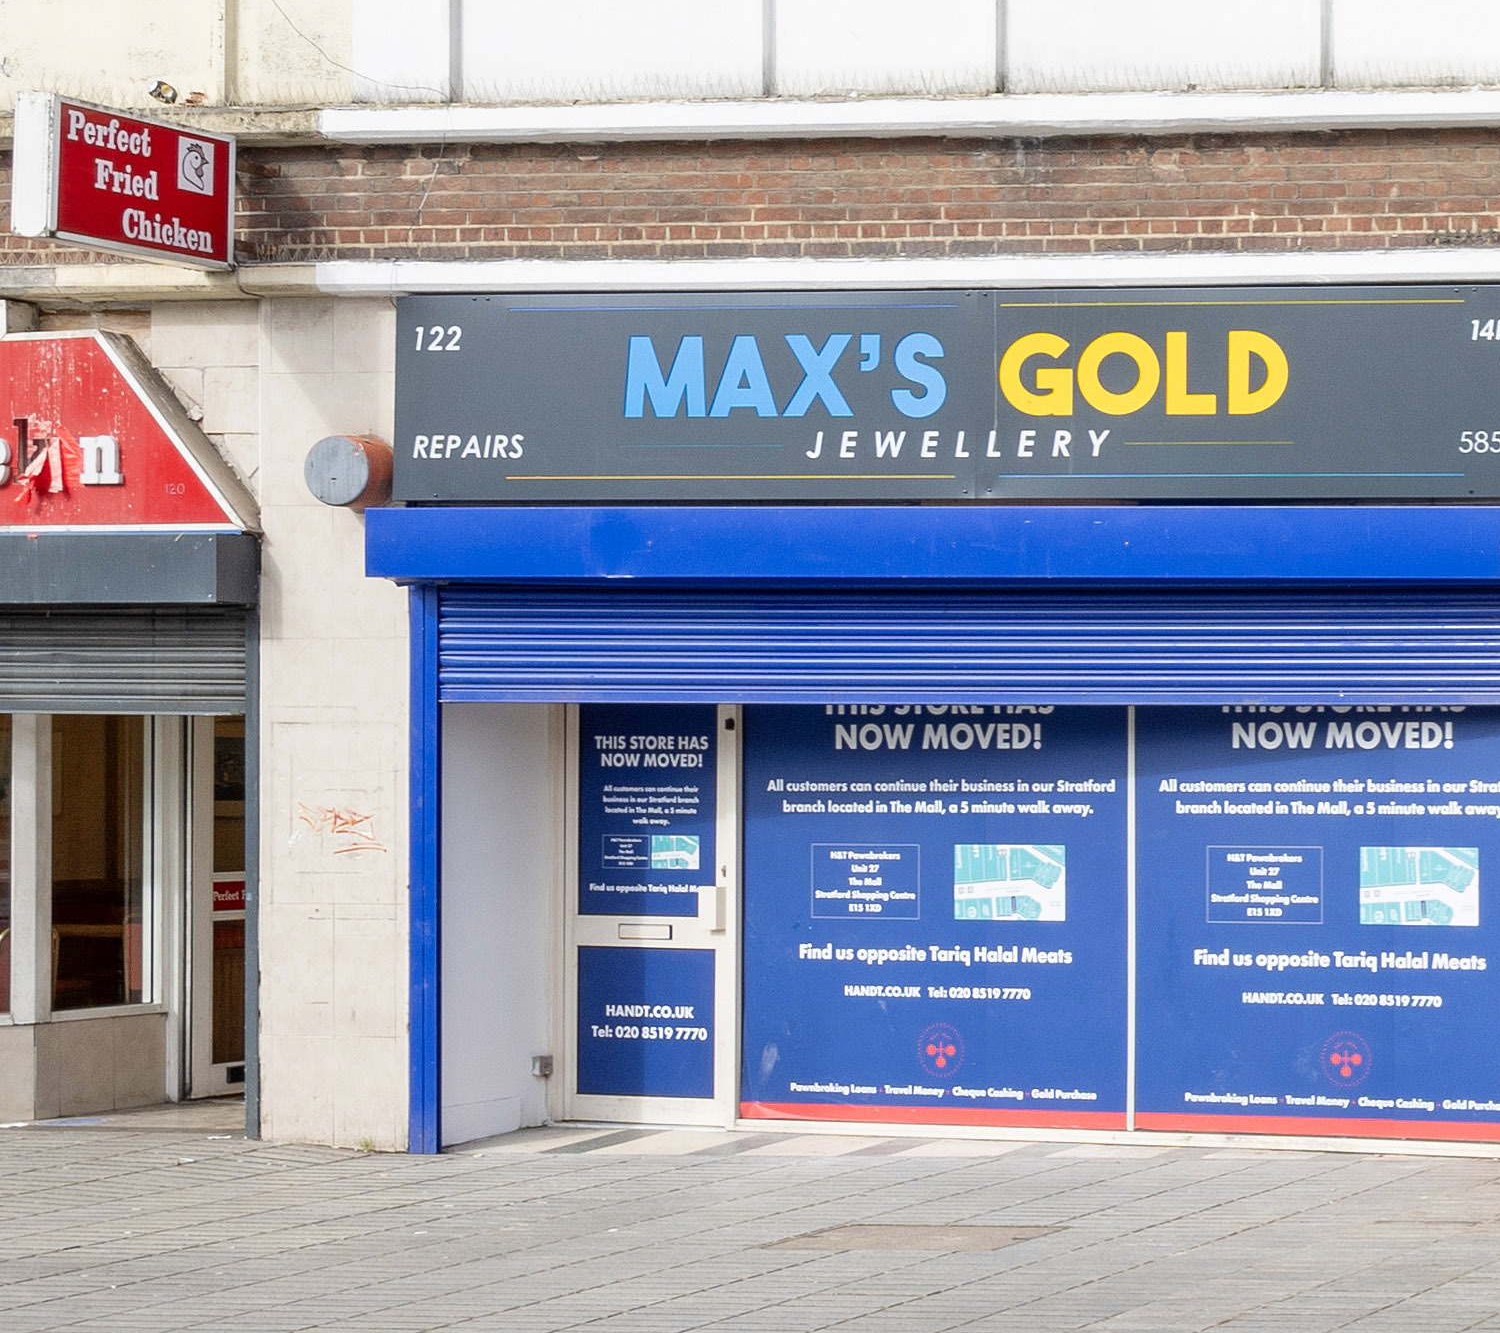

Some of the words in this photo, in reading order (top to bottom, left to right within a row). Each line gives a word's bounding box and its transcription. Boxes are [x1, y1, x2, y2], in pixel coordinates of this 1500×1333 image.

[68, 108, 154, 157] Perfect
[94, 158, 159, 201] Fried
[122, 207, 213, 254] Chicken
[416, 326, 461, 350] 122
[624, 333, 946, 417] MAX'S
[999, 331, 1288, 416] GOLD
[413, 435, 524, 458] REPAIRS
[806, 430, 1110, 458] JEWELLERY
[595, 736, 626, 749] THIS
[630, 736, 674, 749] STORE
[678, 736, 708, 750] HAS
[836, 724, 914, 750] NOW
[922, 723, 1041, 750] MOVED!
[602, 754, 640, 767] NOW
[644, 754, 702, 767] MOVED!
[767, 779, 783, 791] All
[787, 781, 847, 791] customers
[850, 783, 871, 791] can
[875, 780, 927, 791] continue
[930, 779, 959, 791] their
[962, 779, 1014, 792] business
[1017, 779, 1029, 791] in
[1032, 783, 1054, 792] our
[1057, 779, 1115, 792] Stratford
[800, 943, 832, 959] Find
[836, 949, 854, 960] us
[857, 945, 926, 965] opposite
[929, 946, 970, 966] Tariq
[974, 946, 1018, 962] Halal
[1021, 948, 1072, 963] Meats
[607, 1005, 694, 1018] HANDT.CO.UK
[592, 1025, 612, 1037] Tel:
[616, 1026, 639, 1038] 020
[642, 1027, 673, 1039] 8519
[676, 1028, 707, 1040] 7770
